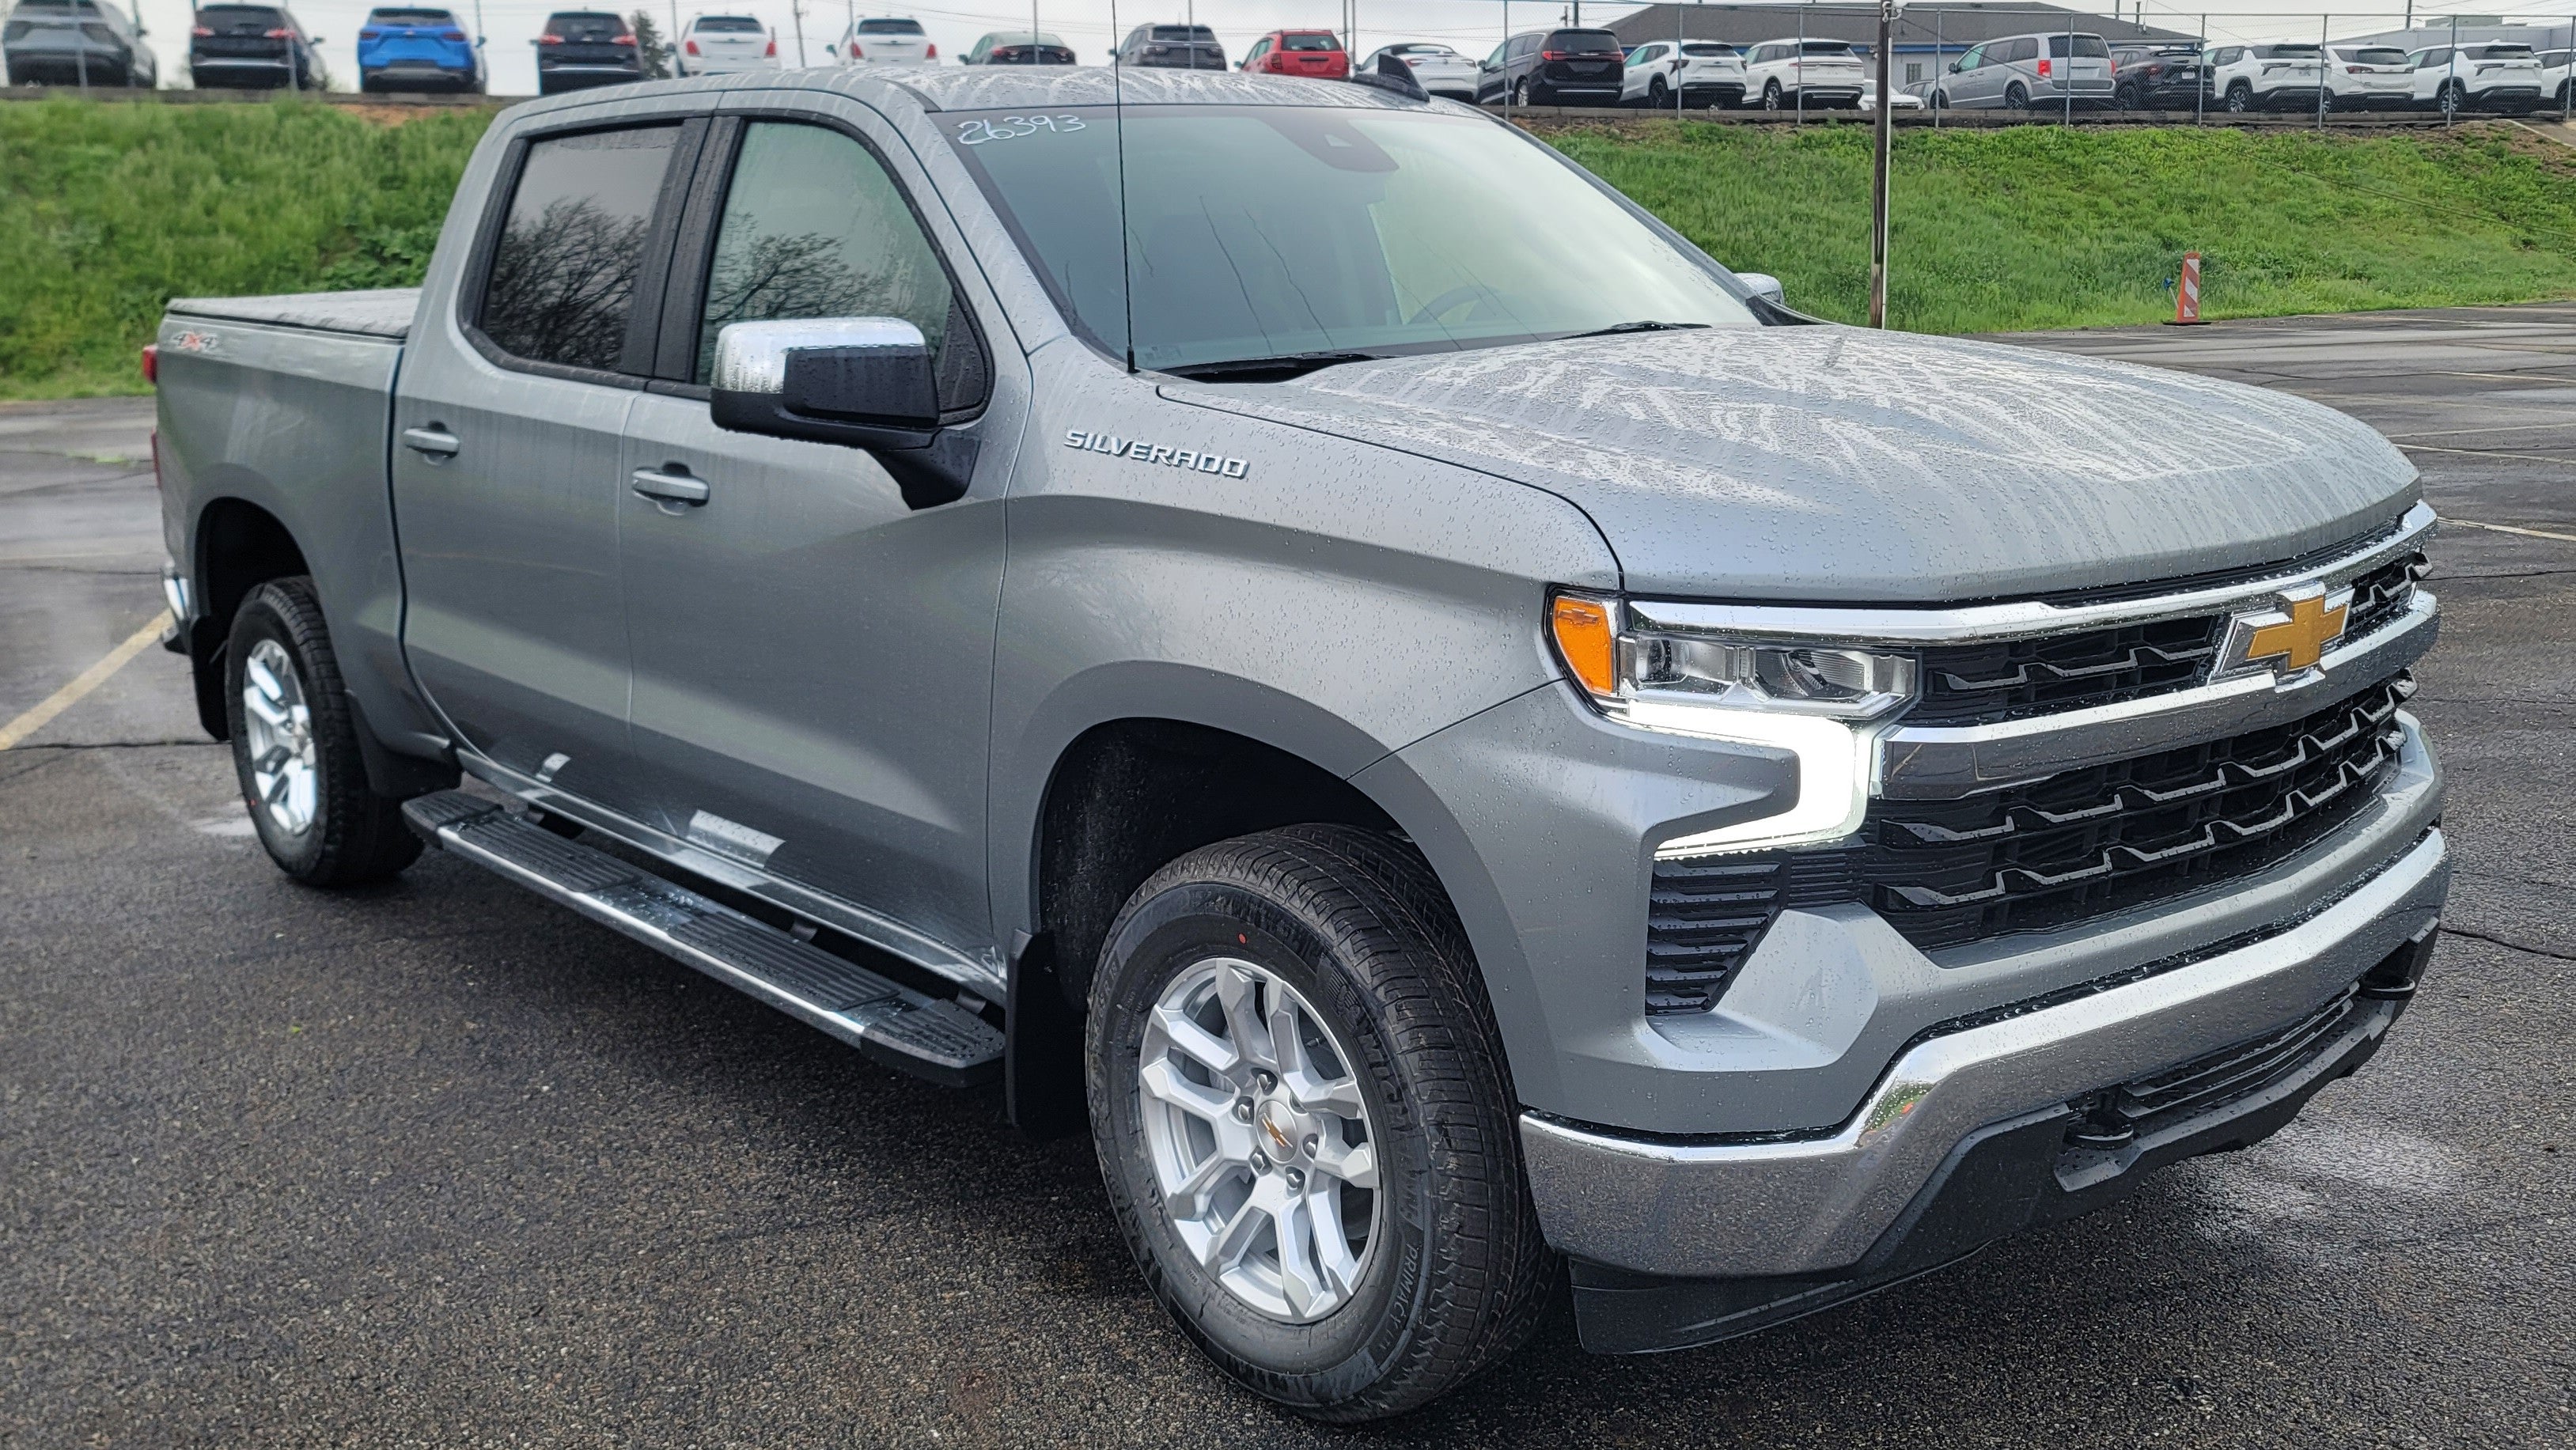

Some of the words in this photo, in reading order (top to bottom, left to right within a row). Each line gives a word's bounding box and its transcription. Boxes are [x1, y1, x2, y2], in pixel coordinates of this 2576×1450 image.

[957, 115, 1086, 145] 26393
[1064, 430, 1250, 479] SILVERADO
[1389, 1243, 1419, 1329] PRIMACY
